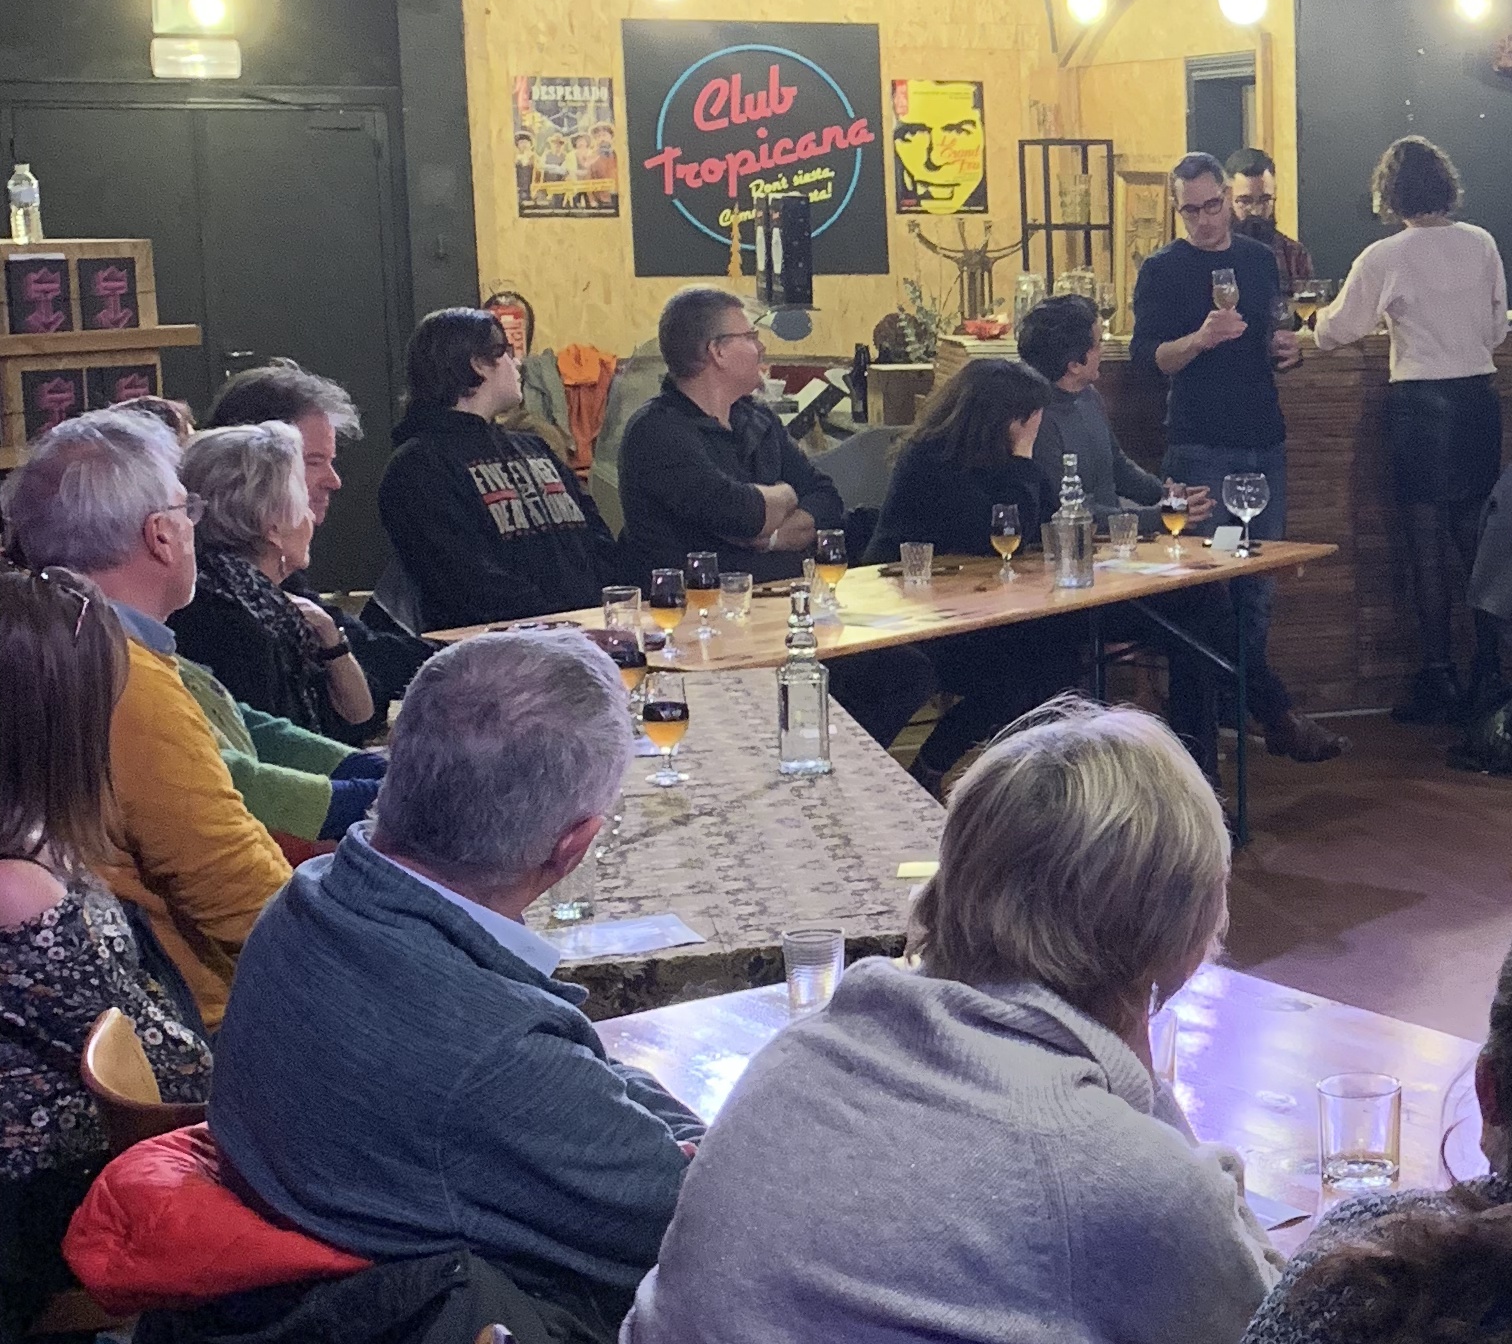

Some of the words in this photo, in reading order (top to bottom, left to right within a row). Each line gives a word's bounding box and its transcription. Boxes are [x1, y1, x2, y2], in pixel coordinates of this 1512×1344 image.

[531, 84, 609, 102] DESPERADO
[694, 64, 797, 131] Club
[644, 118, 875, 198] Tropicana
